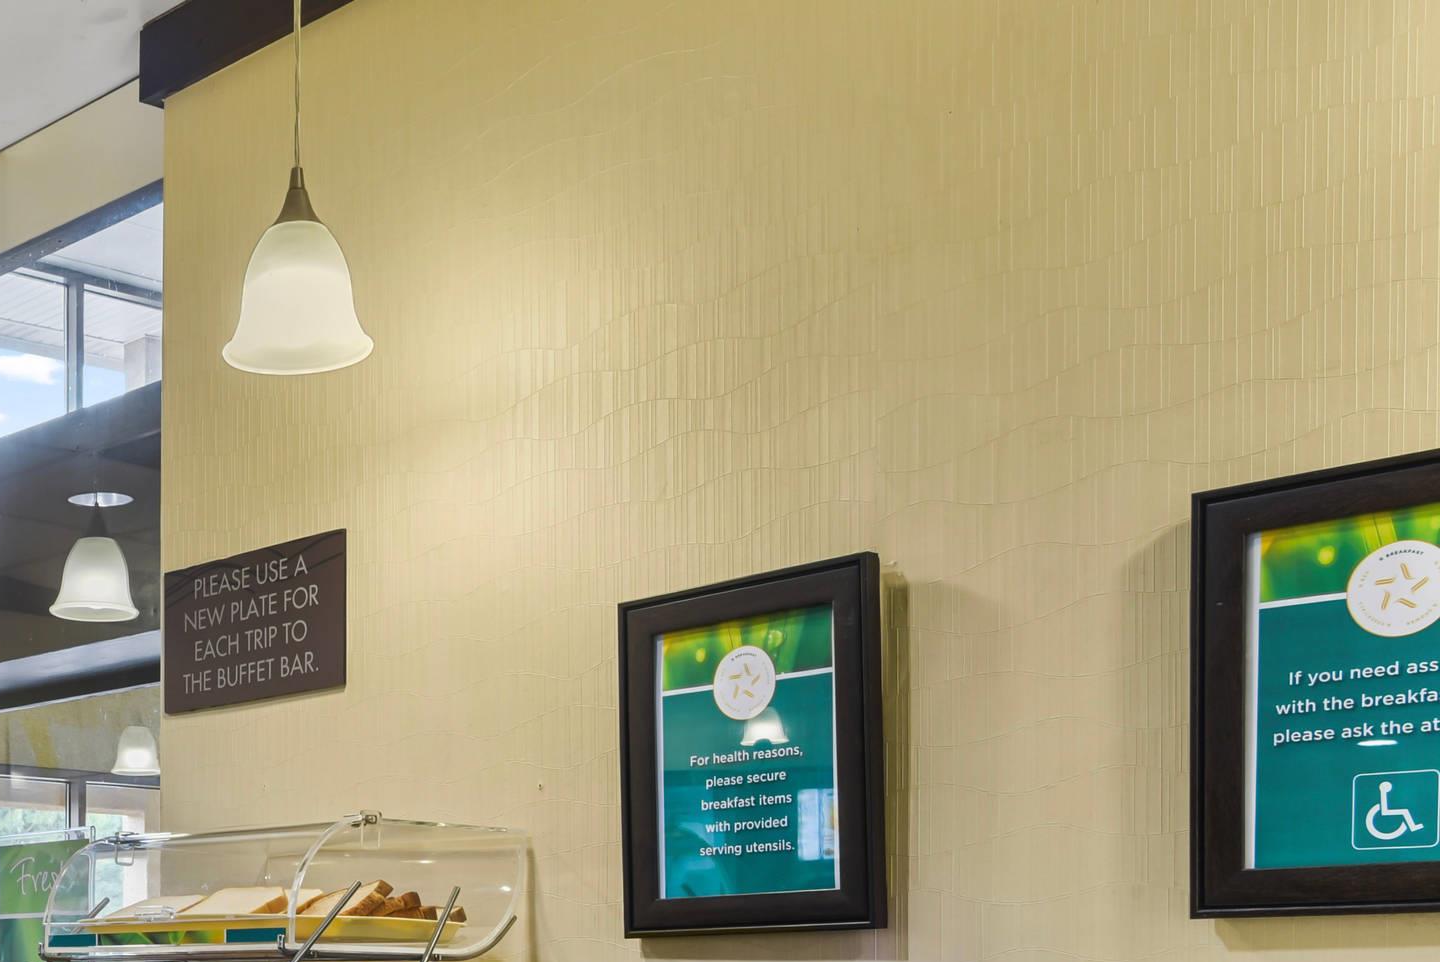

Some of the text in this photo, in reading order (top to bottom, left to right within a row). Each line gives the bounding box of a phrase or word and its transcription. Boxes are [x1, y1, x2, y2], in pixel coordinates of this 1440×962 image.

[194, 555, 308, 600] PLEASE USE A
[184, 584, 319, 632] NEW PLATE FOR
[194, 620, 307, 661] EACH TRIP TO
[183, 651, 319, 694] THE BUFFET BAR.
[1289, 671, 1303, 686] If
[1308, 670, 1343, 686] you
[1350, 661, 1400, 680] need
[1276, 688, 1440, 715] with the breakfa
[1273, 729, 1335, 746] please
[1341, 723, 1373, 739] ask
[1381, 720, 1414, 736] the
[690, 746, 803, 766] For health reasons,
[705, 771, 787, 790] please secure
[701, 794, 792, 811] breakfast items
[705, 816, 788, 833] with provided
[700, 840, 795, 856] serving utensils.
